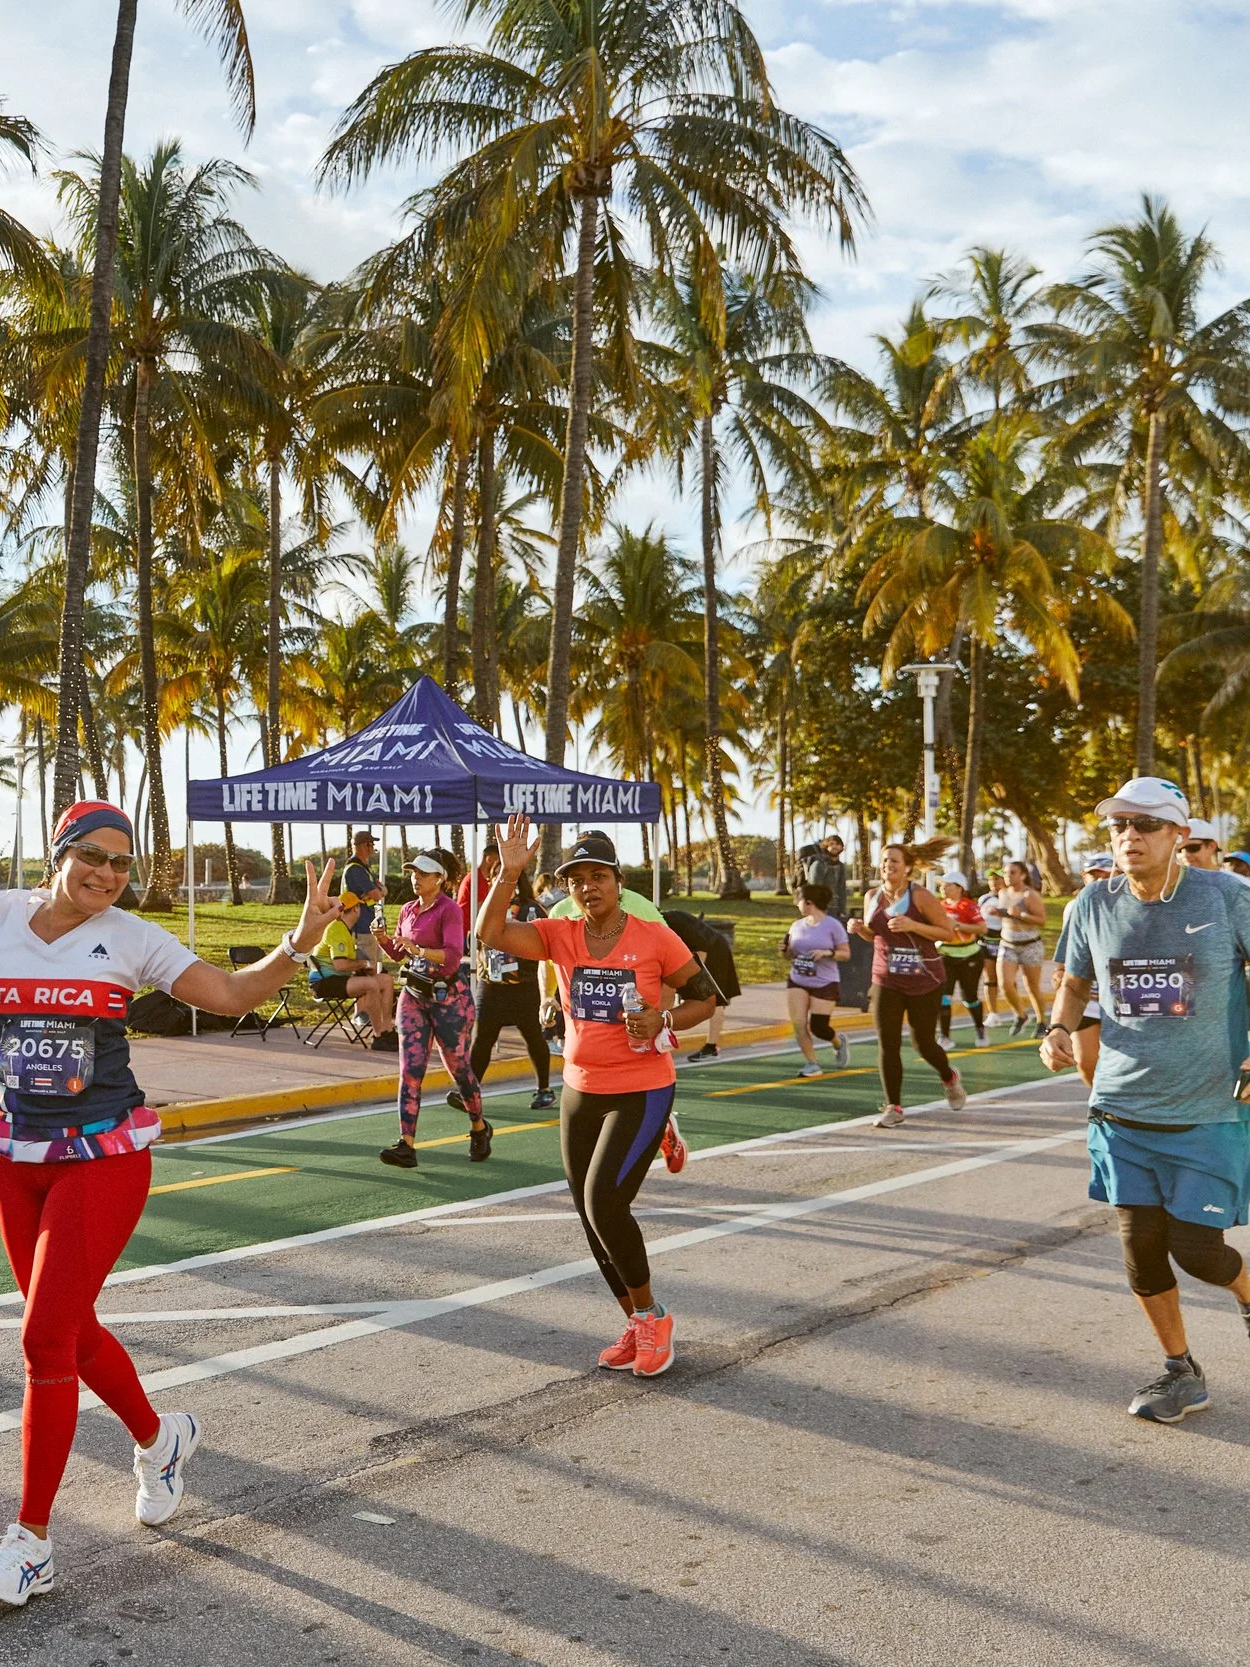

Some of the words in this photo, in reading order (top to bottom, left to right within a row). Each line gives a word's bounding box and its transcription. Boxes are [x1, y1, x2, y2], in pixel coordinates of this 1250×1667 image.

[308, 739, 439, 767] MIAMI
[327, 781, 433, 813] MIAMI
[577, 784, 641, 814] MIAMI
[577, 981, 627, 998] 19497
[1116, 973, 1184, 989] 13050
[34, 987, 94, 1007] RICA
[46, 1020, 76, 1029] MIAMI
[7, 1038, 85, 1060] 20675
[26, 1063, 63, 1072] ANGELES
